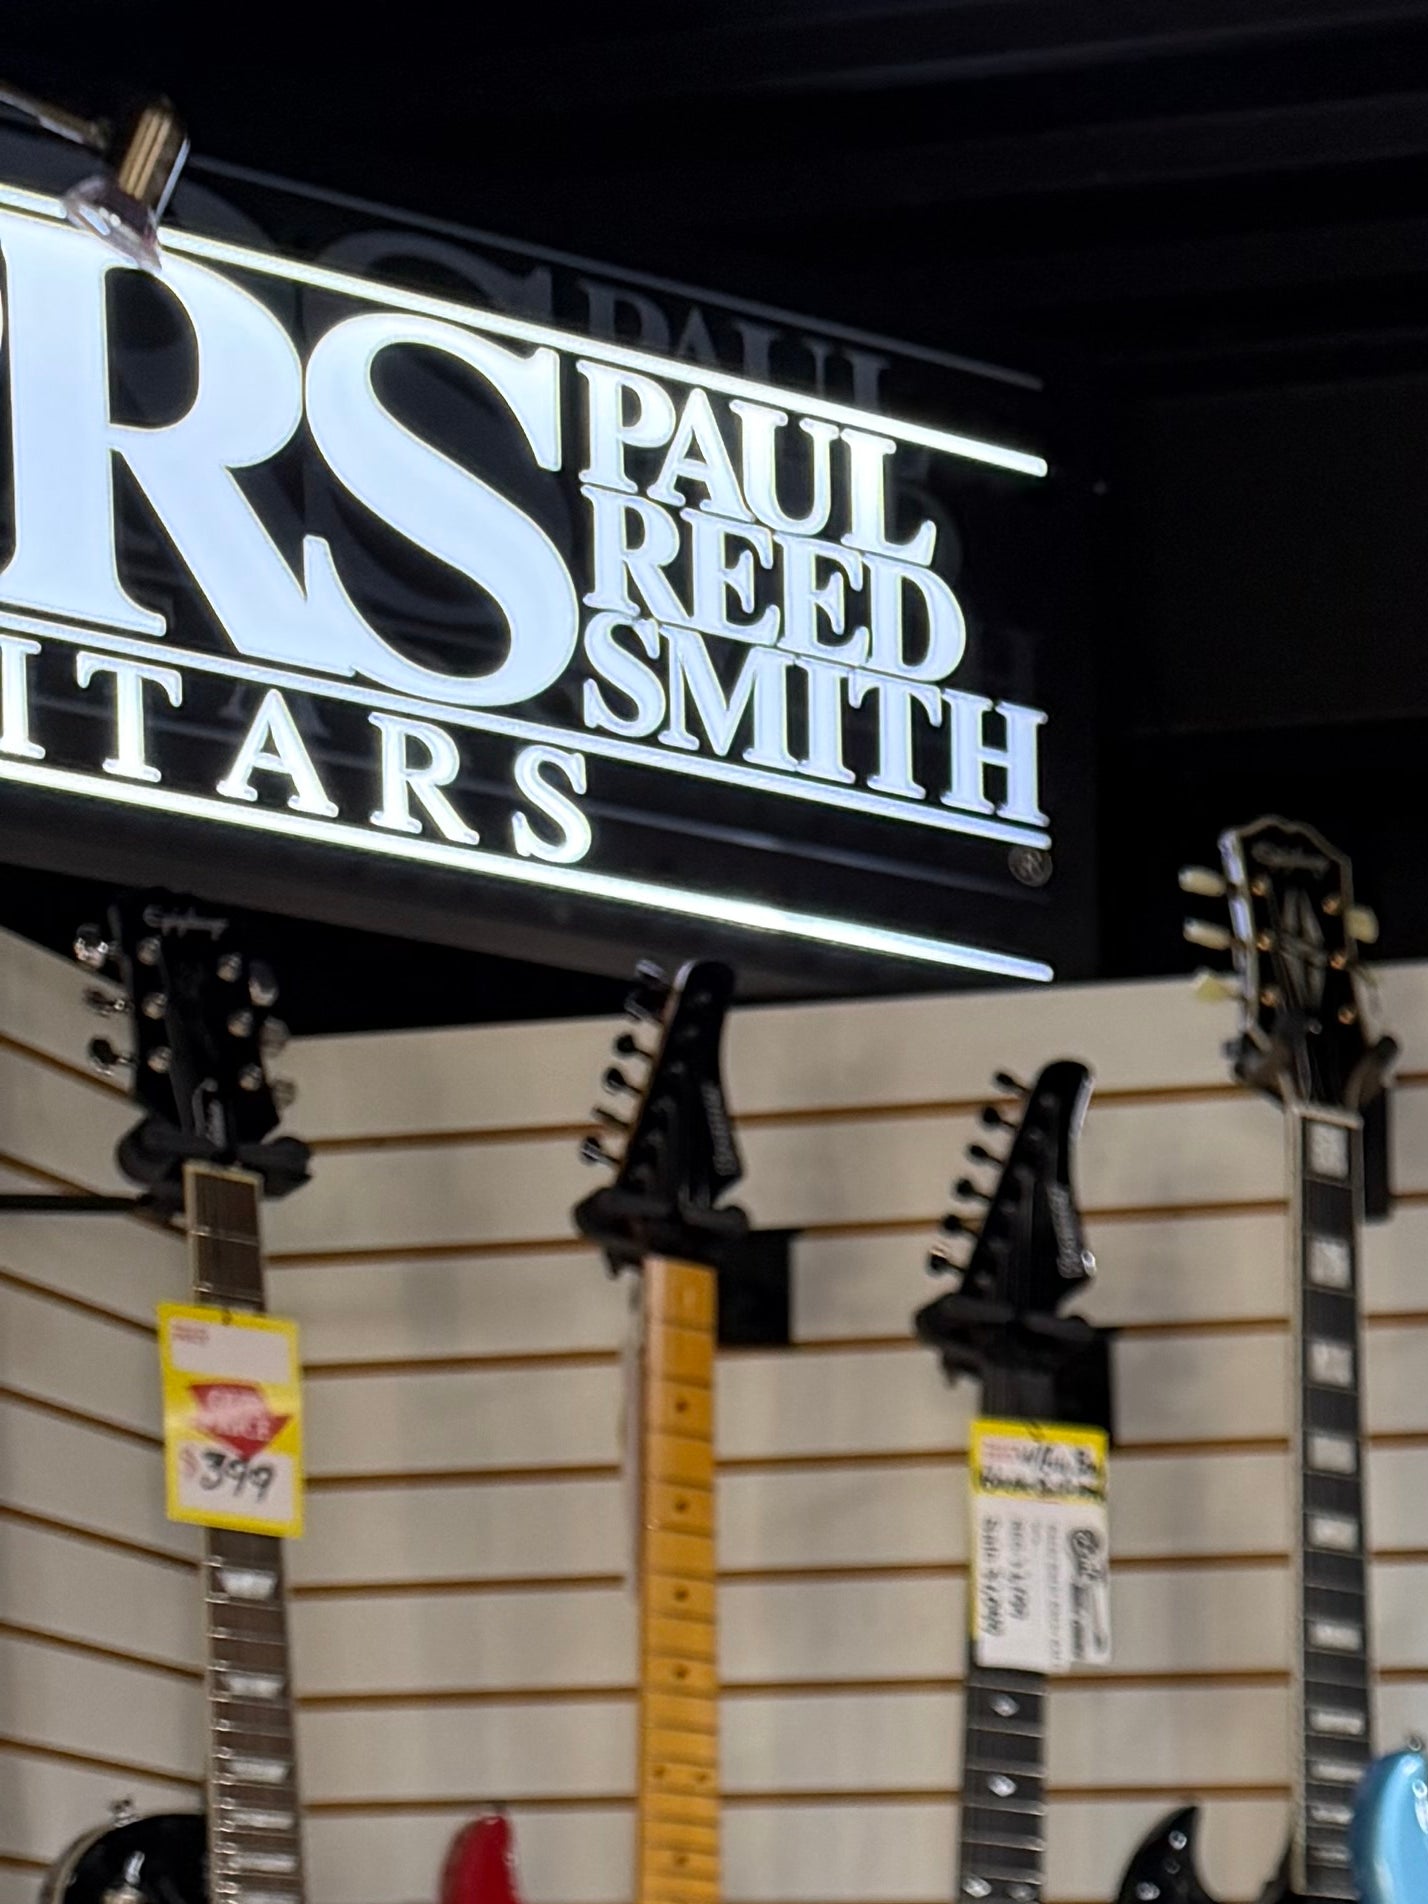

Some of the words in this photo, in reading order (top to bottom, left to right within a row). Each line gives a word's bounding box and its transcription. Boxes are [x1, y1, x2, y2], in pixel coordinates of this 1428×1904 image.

[575, 358, 936, 566] PAUL
[581, 484, 967, 684] REED
[0, 632, 592, 864] ITARS
[582, 612, 1049, 830] SMITH
